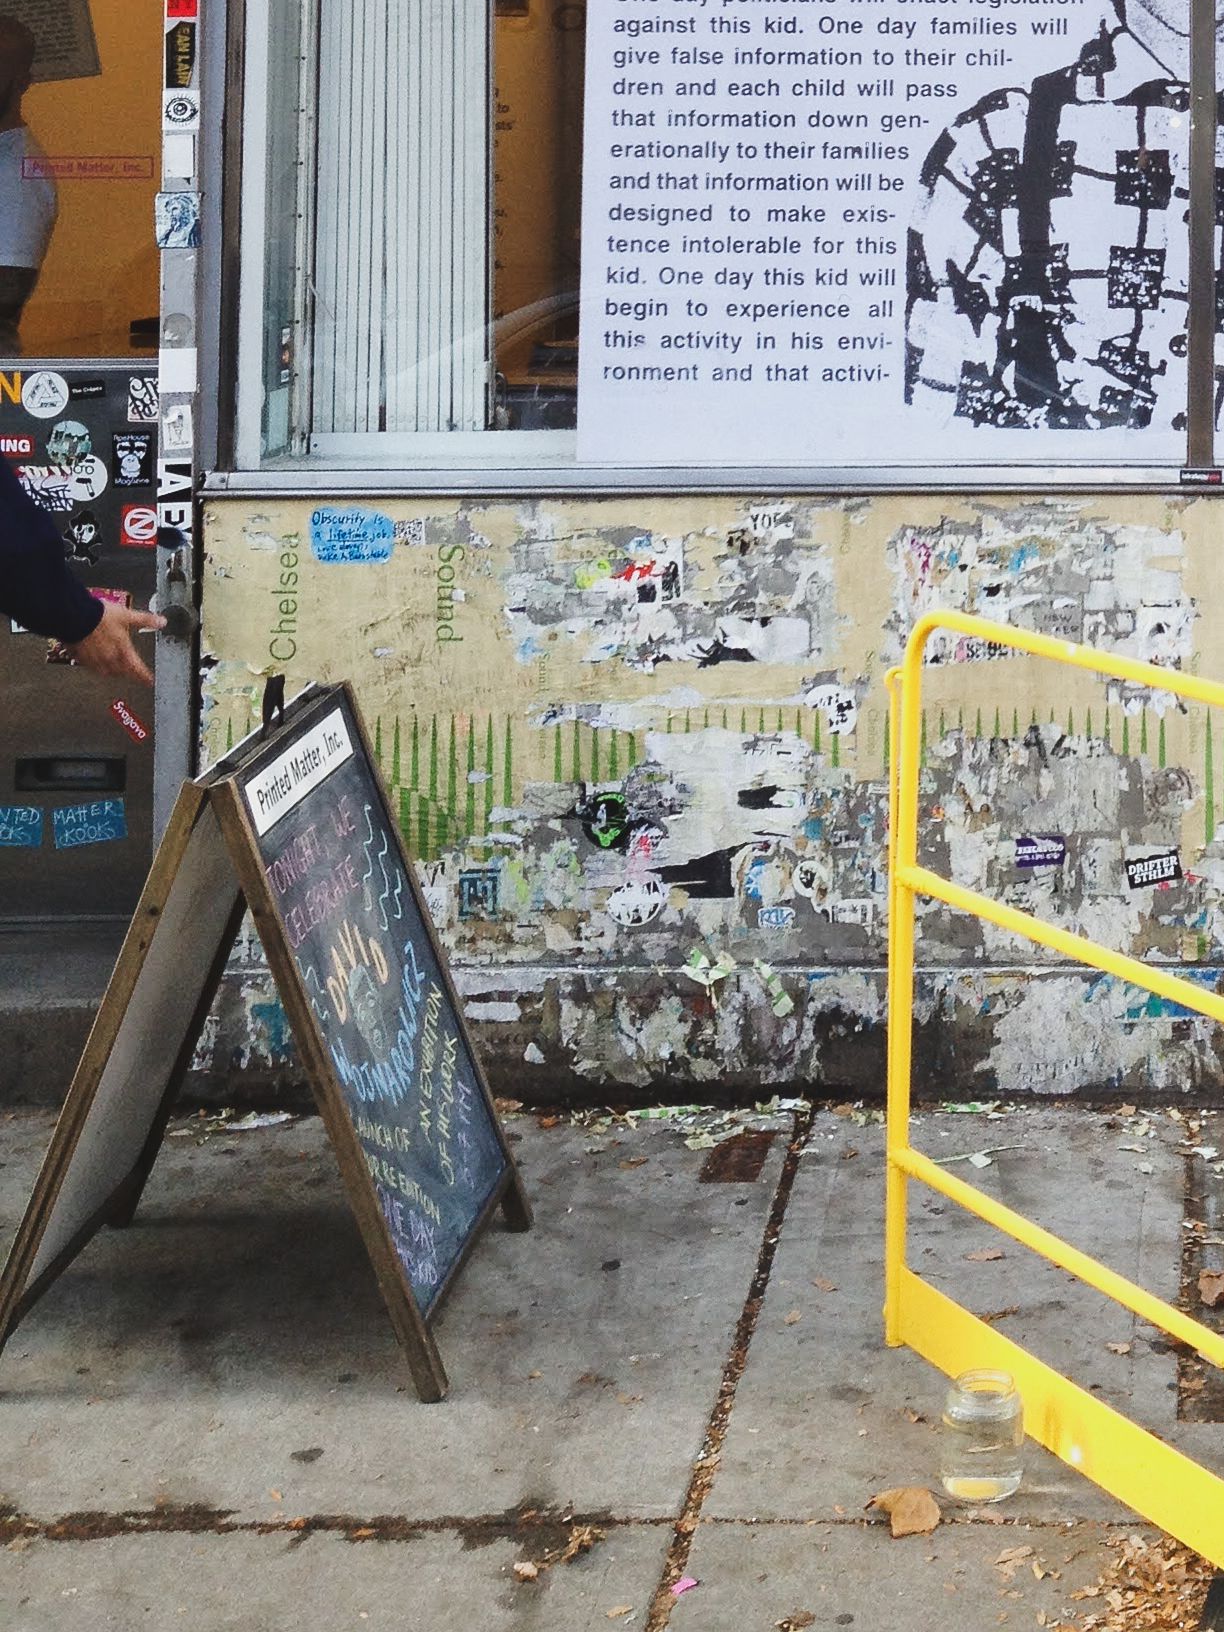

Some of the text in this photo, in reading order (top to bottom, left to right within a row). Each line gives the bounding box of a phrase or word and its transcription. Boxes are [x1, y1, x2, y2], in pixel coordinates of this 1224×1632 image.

[613, 15, 1068, 40] against this kid. One day families will
[604, 297, 893, 323] begin to experience all
[327, 529, 369, 542] lifetime
[269, 531, 299, 661] Chelsea
[436, 544, 464, 643] Sound
[257, 730, 344, 815] Printed Matter, Inc.
[1128, 855, 1179, 876] DRIFTER
[1134, 866, 1175, 884] STHLM
[284, 854, 360, 949] CELEBRATE
[327, 919, 389, 1024] DAVID
